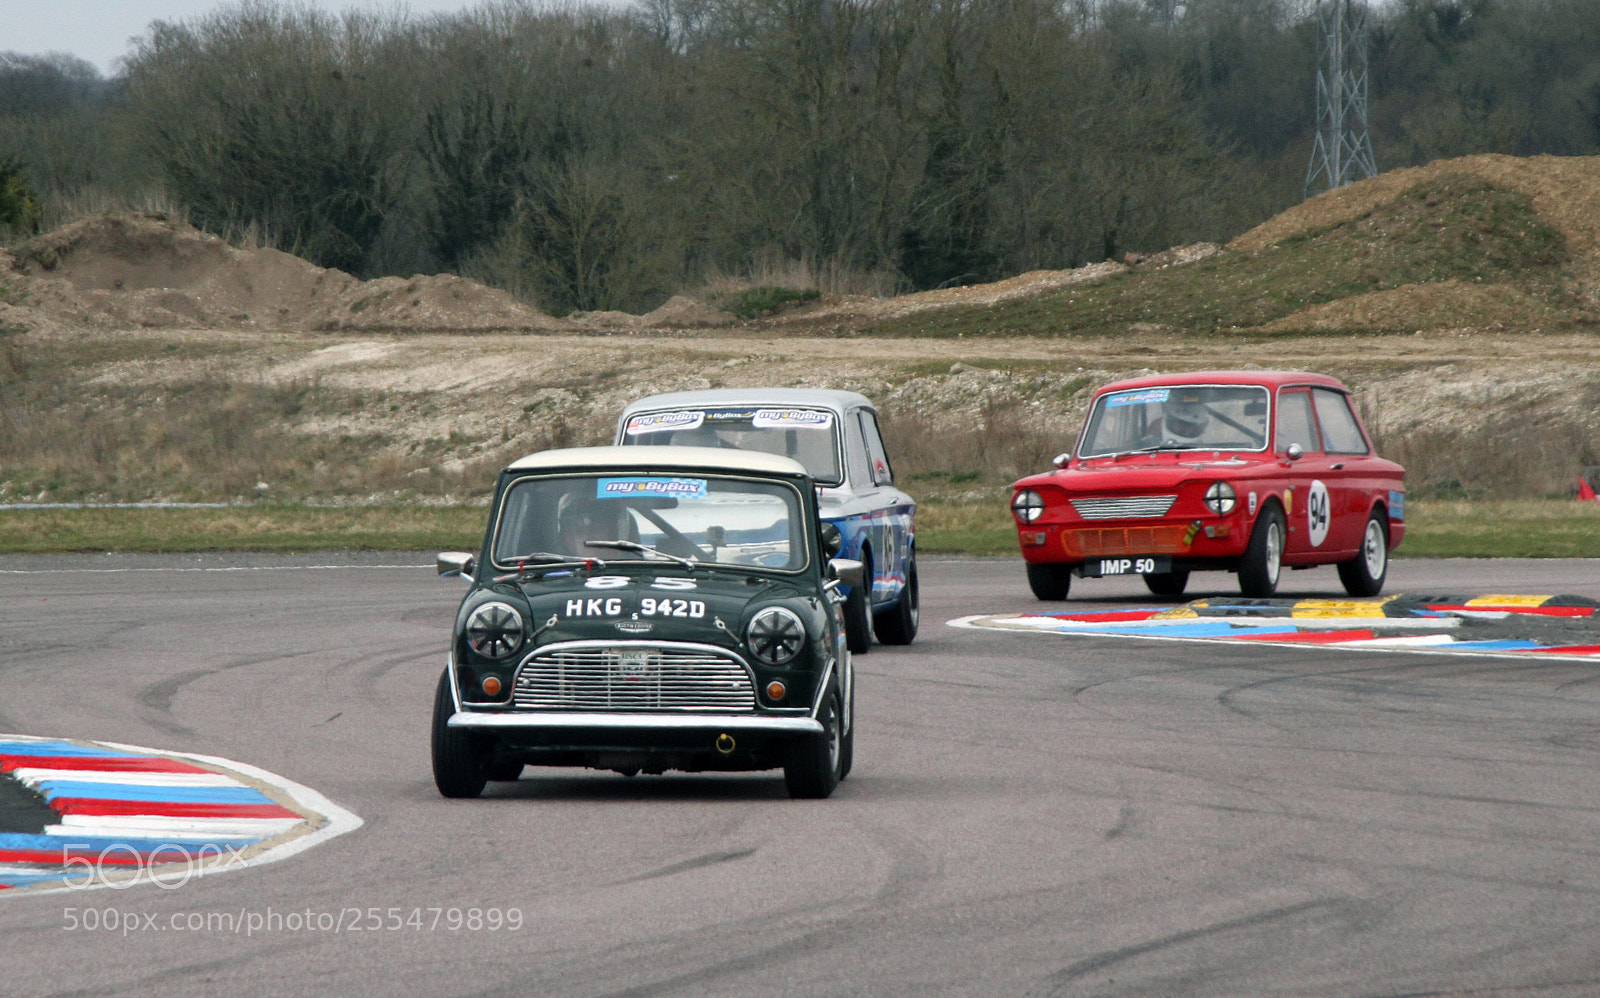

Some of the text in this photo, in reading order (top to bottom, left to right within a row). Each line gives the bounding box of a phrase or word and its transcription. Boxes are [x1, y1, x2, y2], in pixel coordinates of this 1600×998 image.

[1311, 491, 1327, 531] 94
[1100, 558, 1155, 575] IMP 50
[566, 598, 706, 618] HKG 942D
